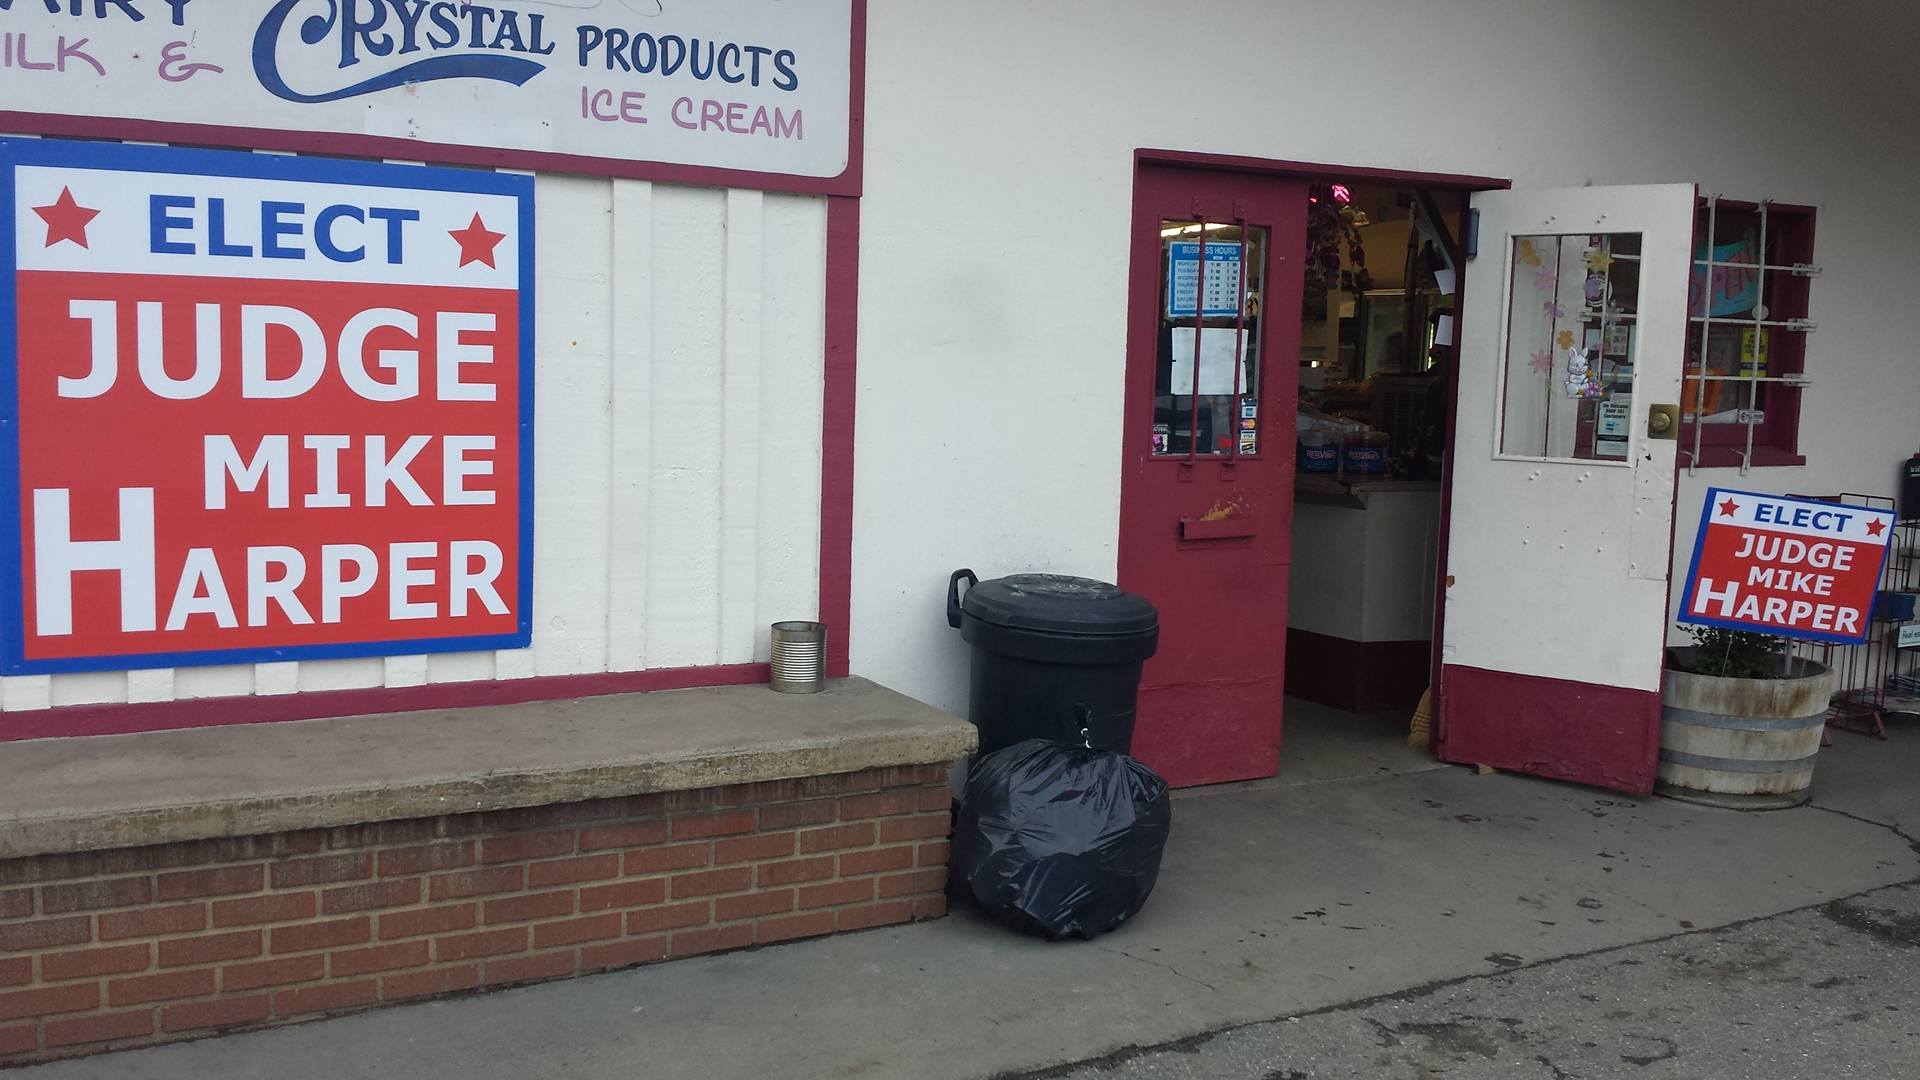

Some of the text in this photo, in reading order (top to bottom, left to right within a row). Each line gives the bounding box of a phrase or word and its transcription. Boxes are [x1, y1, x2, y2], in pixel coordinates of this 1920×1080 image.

[158, 40, 224, 83] &
[252, 0, 556, 104] CRYSTAL
[576, 24, 800, 92] PRODUCTS
[581, 85, 804, 141] ICE CREAM
[149, 193, 420, 265] ELECT
[1182, 246, 1238, 255] BUSISS HOURS
[57, 299, 497, 402] JUDGE
[203, 434, 497, 510] MIKE
[1754, 503, 1853, 533] ELECT
[33, 486, 511, 637] HARPER
[1734, 533, 1856, 572] JUDGE
[1693, 577, 1860, 634] HARPER
[1746, 566, 1835, 597] MIKE
